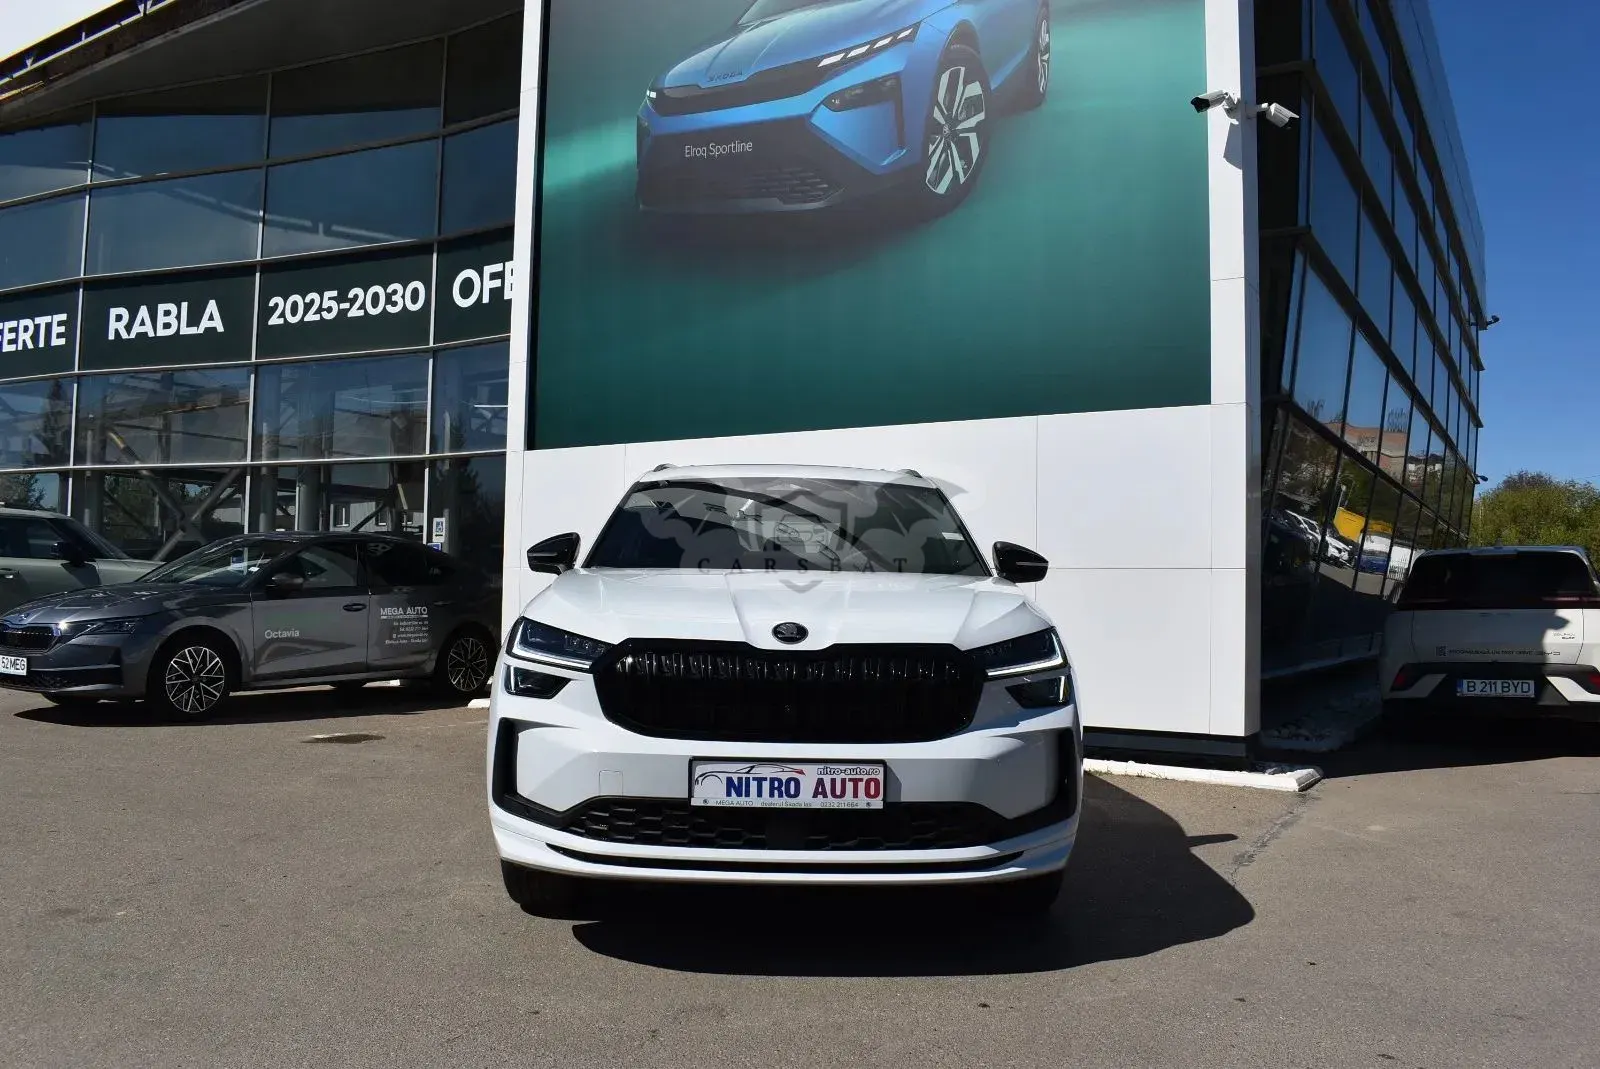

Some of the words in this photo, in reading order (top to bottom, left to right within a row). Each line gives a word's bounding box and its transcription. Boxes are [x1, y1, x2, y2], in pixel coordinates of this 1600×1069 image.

[685, 145, 707, 159] Elroq
[709, 140, 753, 159] Sportline
[0, 314, 67, 352] ERTE
[108, 300, 224, 340] RABLA
[268, 281, 425, 325] 2025-2030
[380, 607, 404, 616] MEGA
[406, 606, 428, 615] AUTO
[264, 628, 300, 639] Octavia
[1466, 681, 1476, 693] B
[1480, 681, 1497, 693] 211
[1501, 681, 1531, 693] BYD
[817, 766, 880, 776] nitro-auto.ro
[725, 776, 800, 799] NITRO
[812, 777, 881, 799] AUTO
